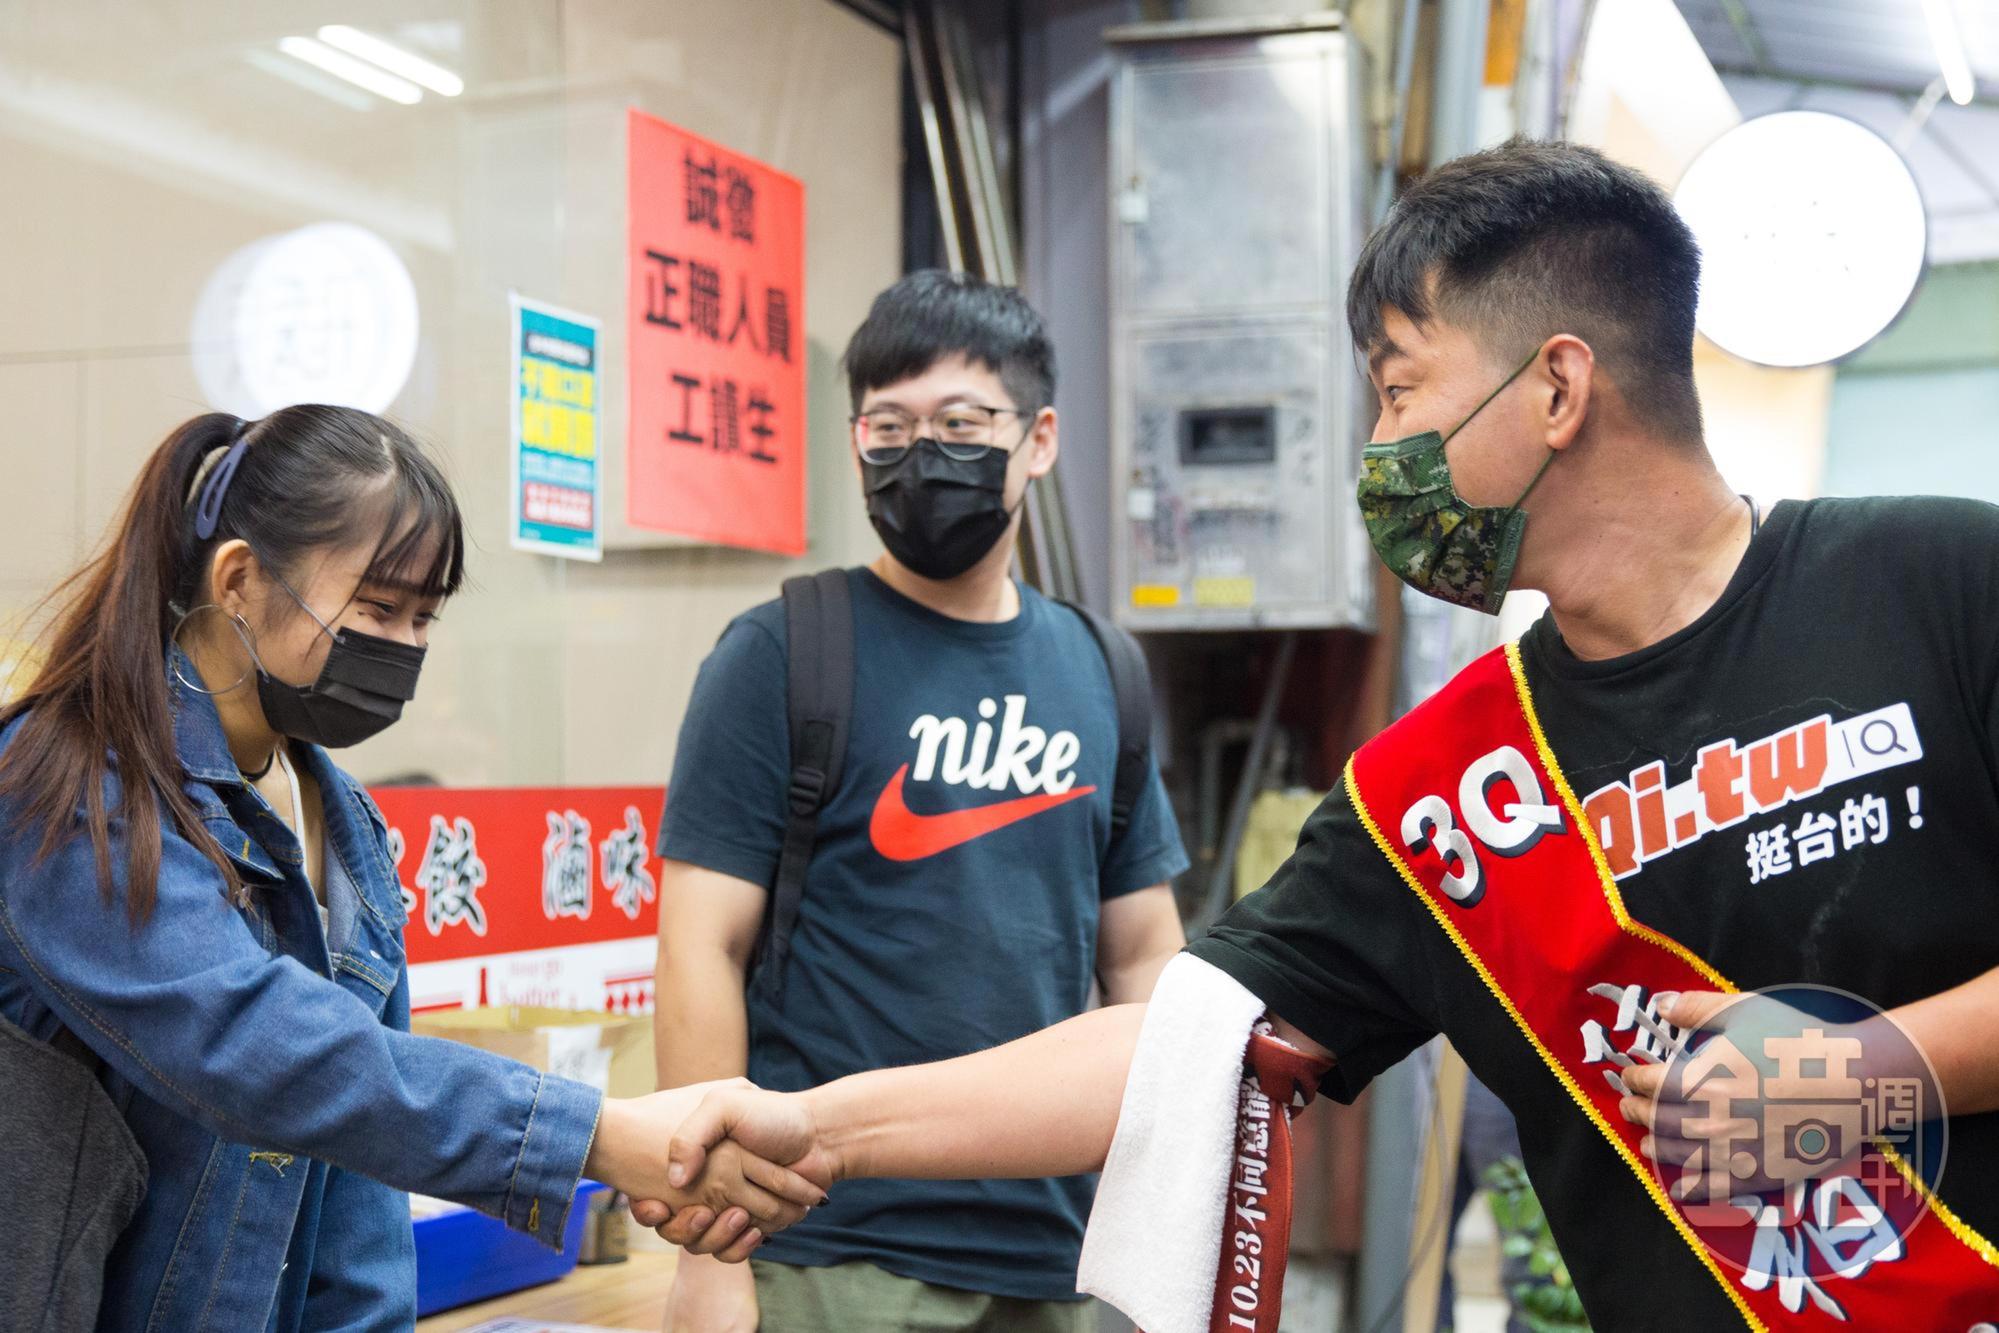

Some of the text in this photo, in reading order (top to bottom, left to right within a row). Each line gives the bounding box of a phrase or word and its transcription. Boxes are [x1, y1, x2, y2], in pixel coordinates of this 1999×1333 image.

[644, 248, 793, 364] 正職人員
[668, 373, 778, 464] 工讀生
[908, 694, 1081, 796] nike
[389, 814, 488, 937] 餃
[1401, 745, 1568, 908] 3Q
